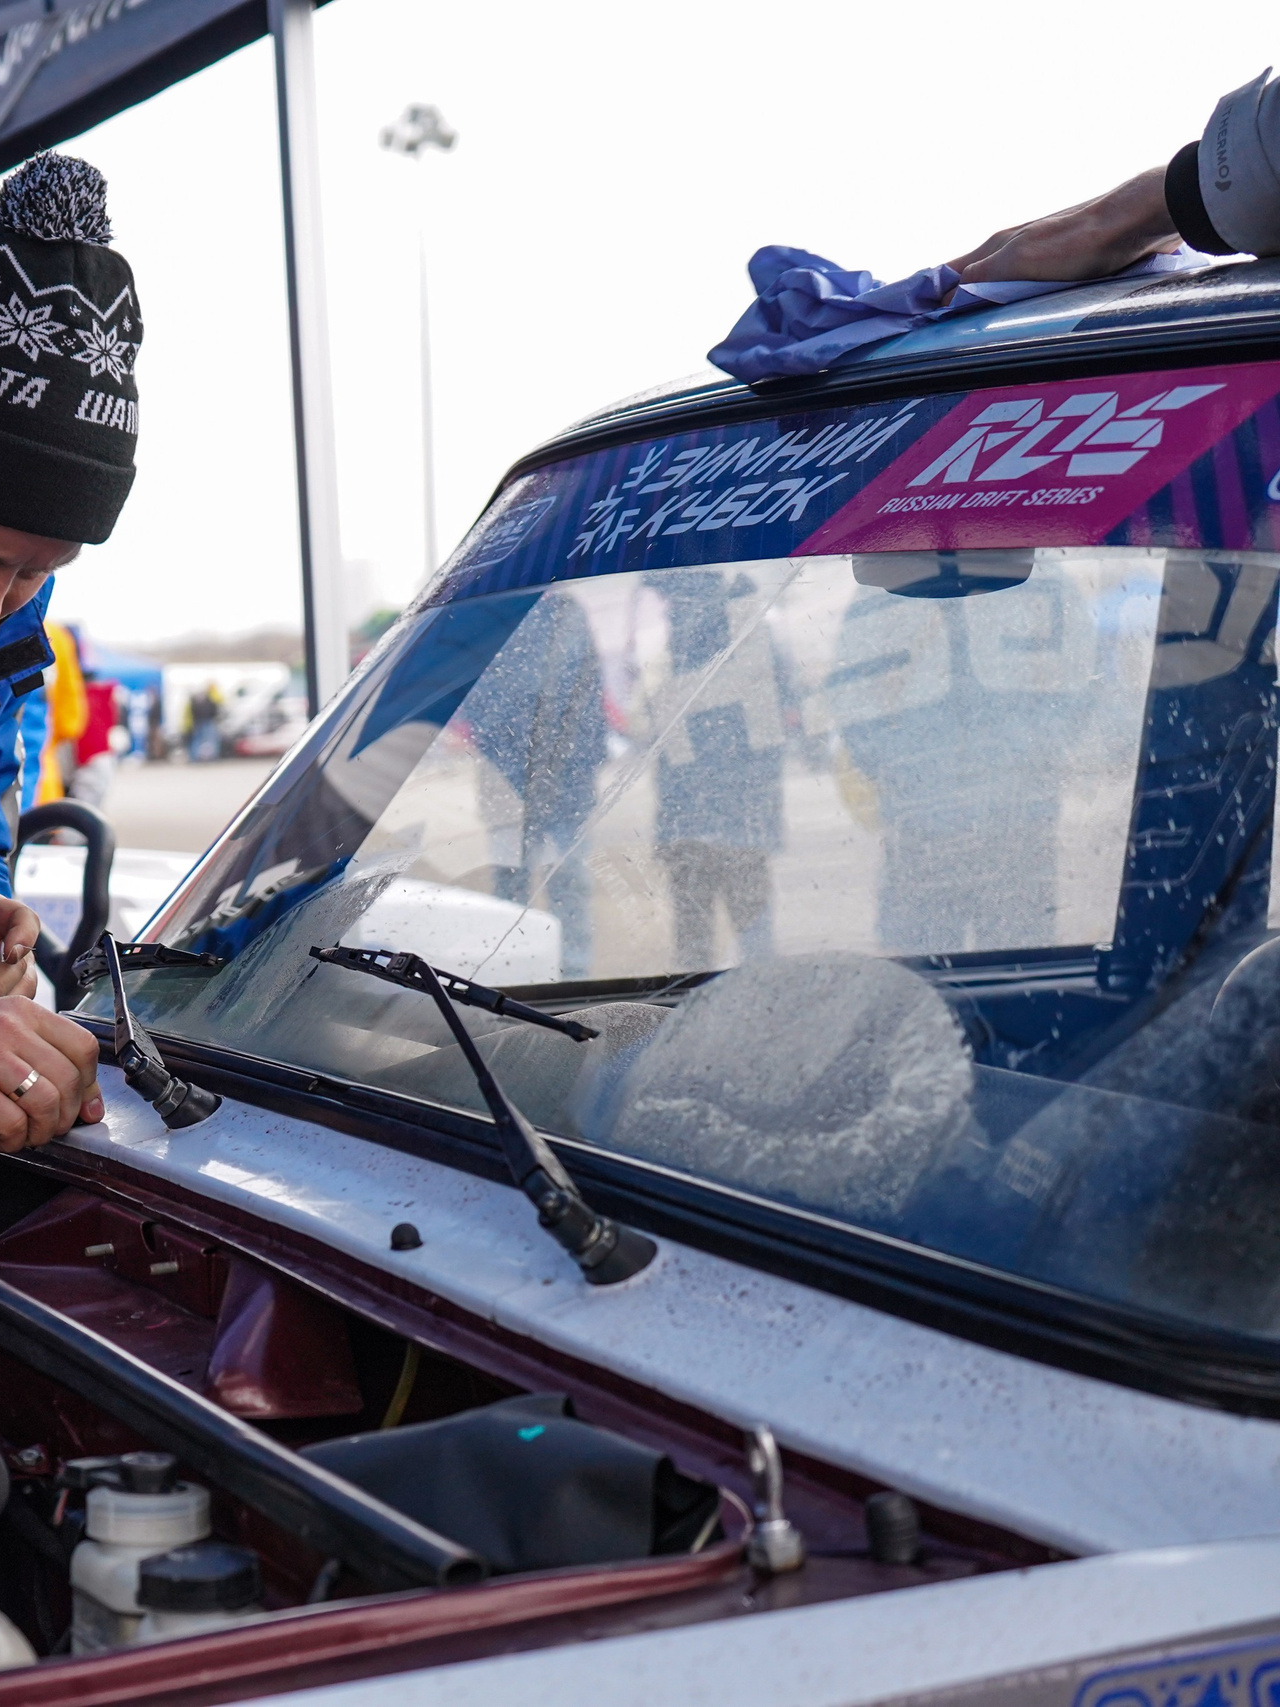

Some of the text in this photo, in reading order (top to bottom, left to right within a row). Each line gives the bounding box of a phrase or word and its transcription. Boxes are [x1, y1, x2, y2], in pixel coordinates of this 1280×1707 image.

[637, 398, 925, 495] ЗИМНИЙ
[906, 383, 1227, 488] RDS
[627, 472, 850, 540] КУБОК
[876, 486, 1105, 514] RUSSIAN DRIFT SERIES
